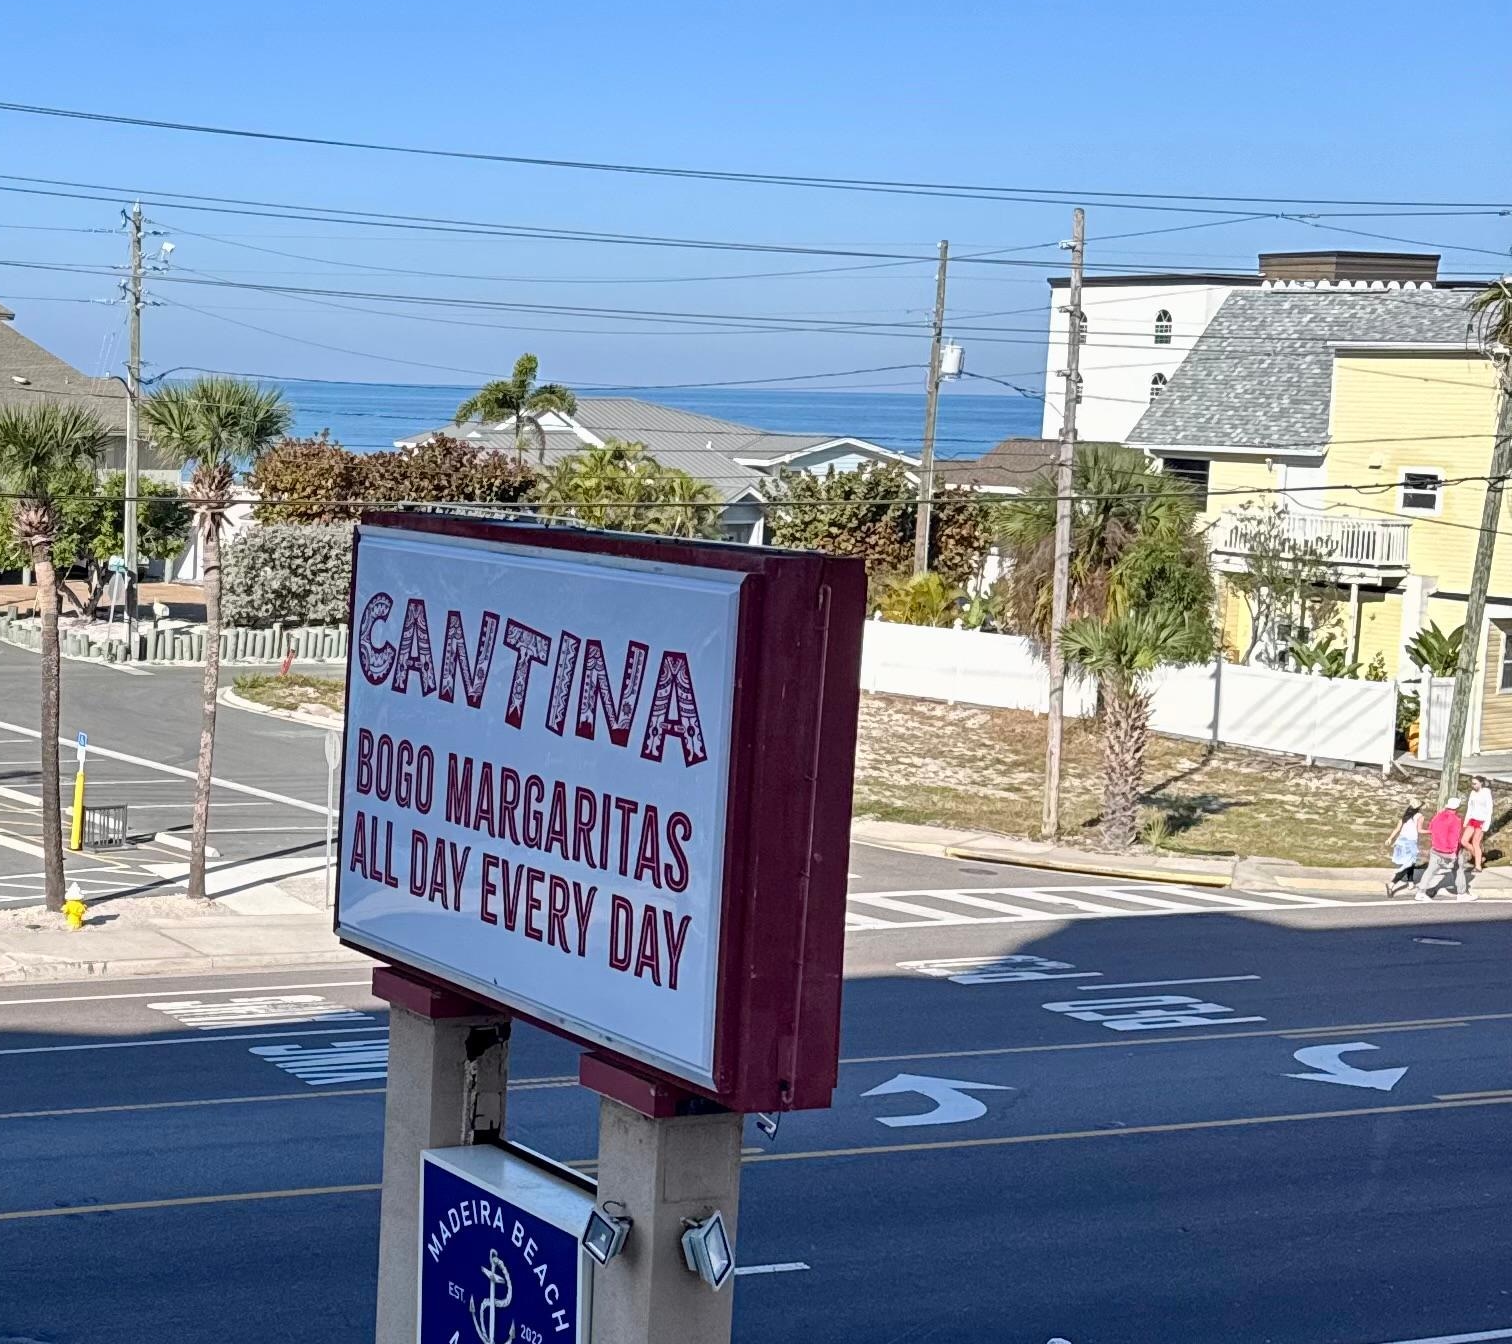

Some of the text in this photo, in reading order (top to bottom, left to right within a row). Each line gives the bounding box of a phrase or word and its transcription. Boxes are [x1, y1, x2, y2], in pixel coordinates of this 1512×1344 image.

[358, 591, 708, 768] CANTINA
[356, 727, 692, 893] BOGO MARGARITAS
[350, 810, 692, 991] ALL DAY EVERY DAY
[427, 1199, 570, 1333] MADEIRA BEACH
[448, 1281, 465, 1304] EST.
